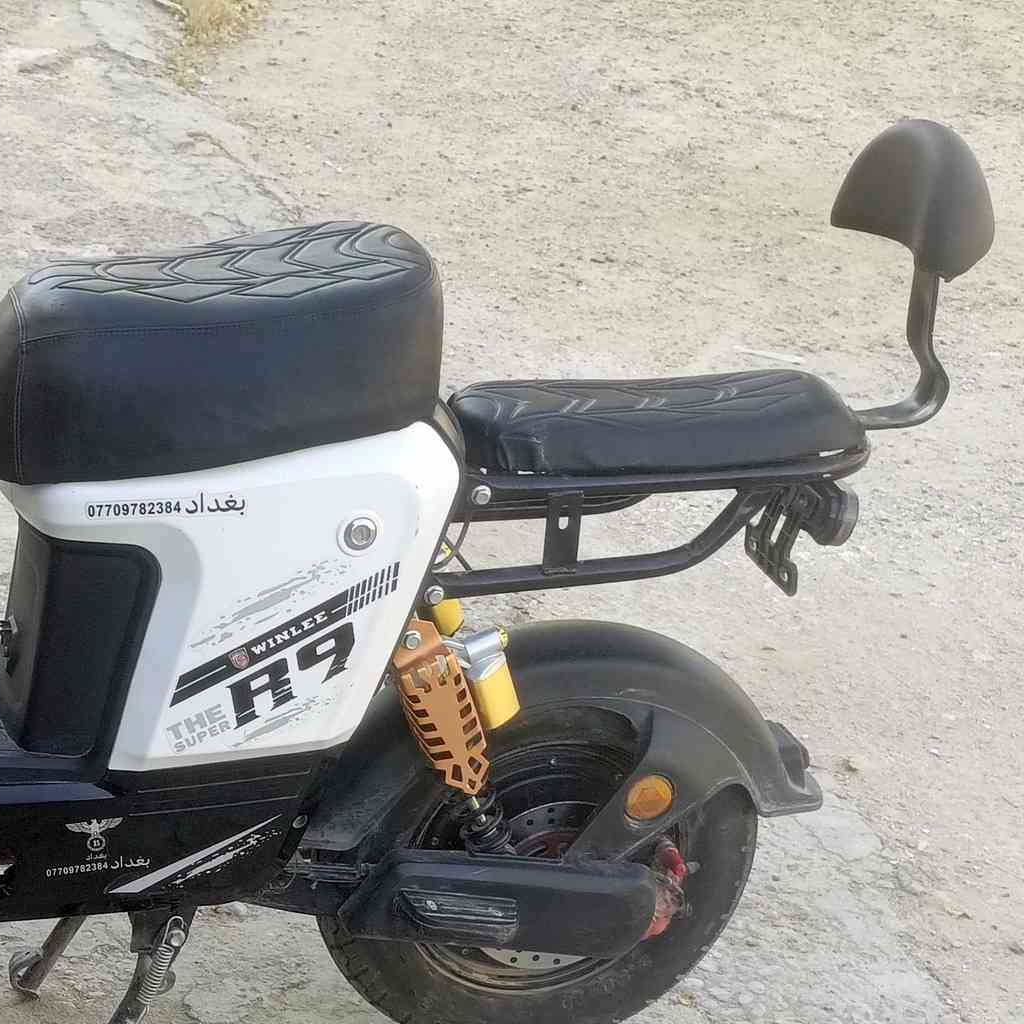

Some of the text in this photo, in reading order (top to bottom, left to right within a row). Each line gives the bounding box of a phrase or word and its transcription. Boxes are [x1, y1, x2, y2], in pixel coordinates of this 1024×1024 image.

[87, 492, 247, 518] بغداد 07709782384
[250, 610, 329, 656] WINLEE
[226, 622, 356, 730] R9
[166, 703, 227, 740] THE
[173, 720, 233, 753] SUPER
[46, 855, 151, 877] بغداد 07709782384
